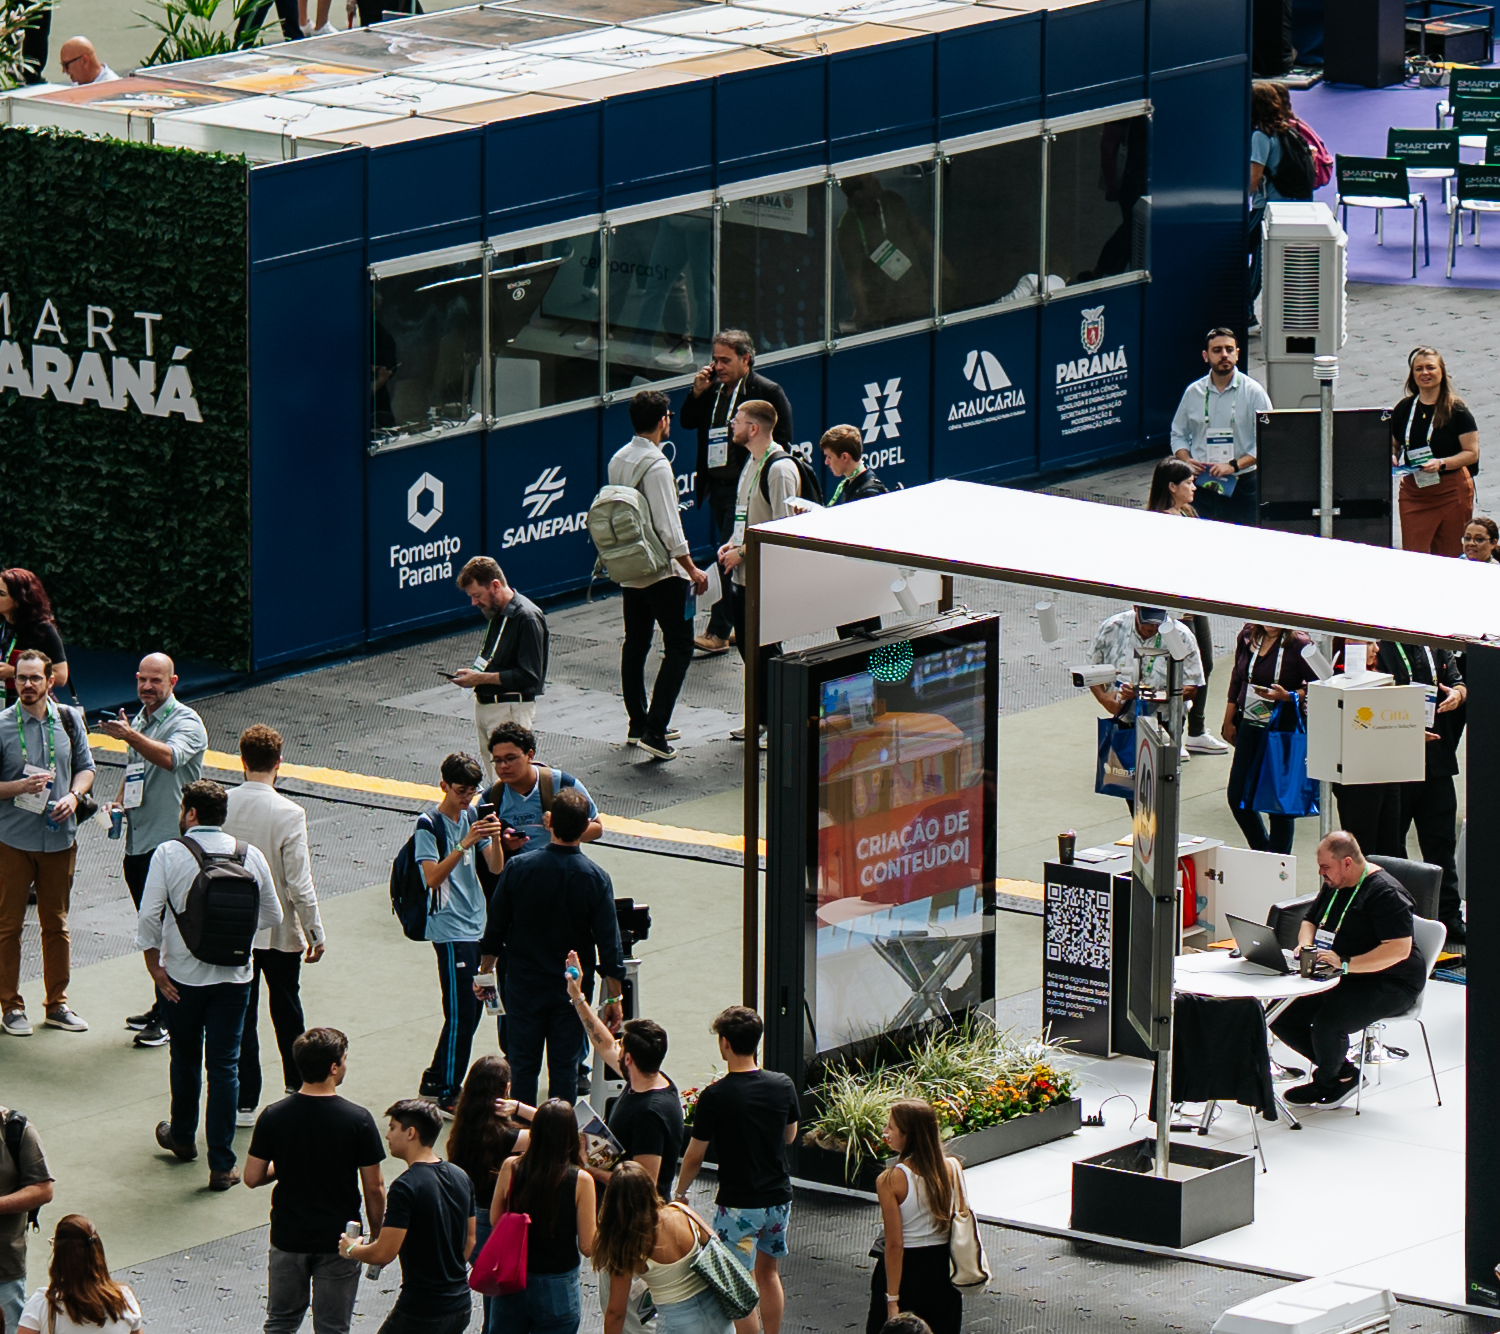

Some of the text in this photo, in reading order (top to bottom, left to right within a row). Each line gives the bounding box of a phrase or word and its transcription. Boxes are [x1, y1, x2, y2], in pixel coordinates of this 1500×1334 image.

[1342, 170, 1398, 180] SMARTCITY
[1056, 345, 1128, 384] PARANÁ
[948, 389, 1026, 422] ARAUCARIA
[502, 512, 588, 550] SANEPAR
[390, 534, 461, 568] Fomento
[398, 559, 453, 590] Paraná
[855, 810, 970, 863] CRIAÇÃO DE
